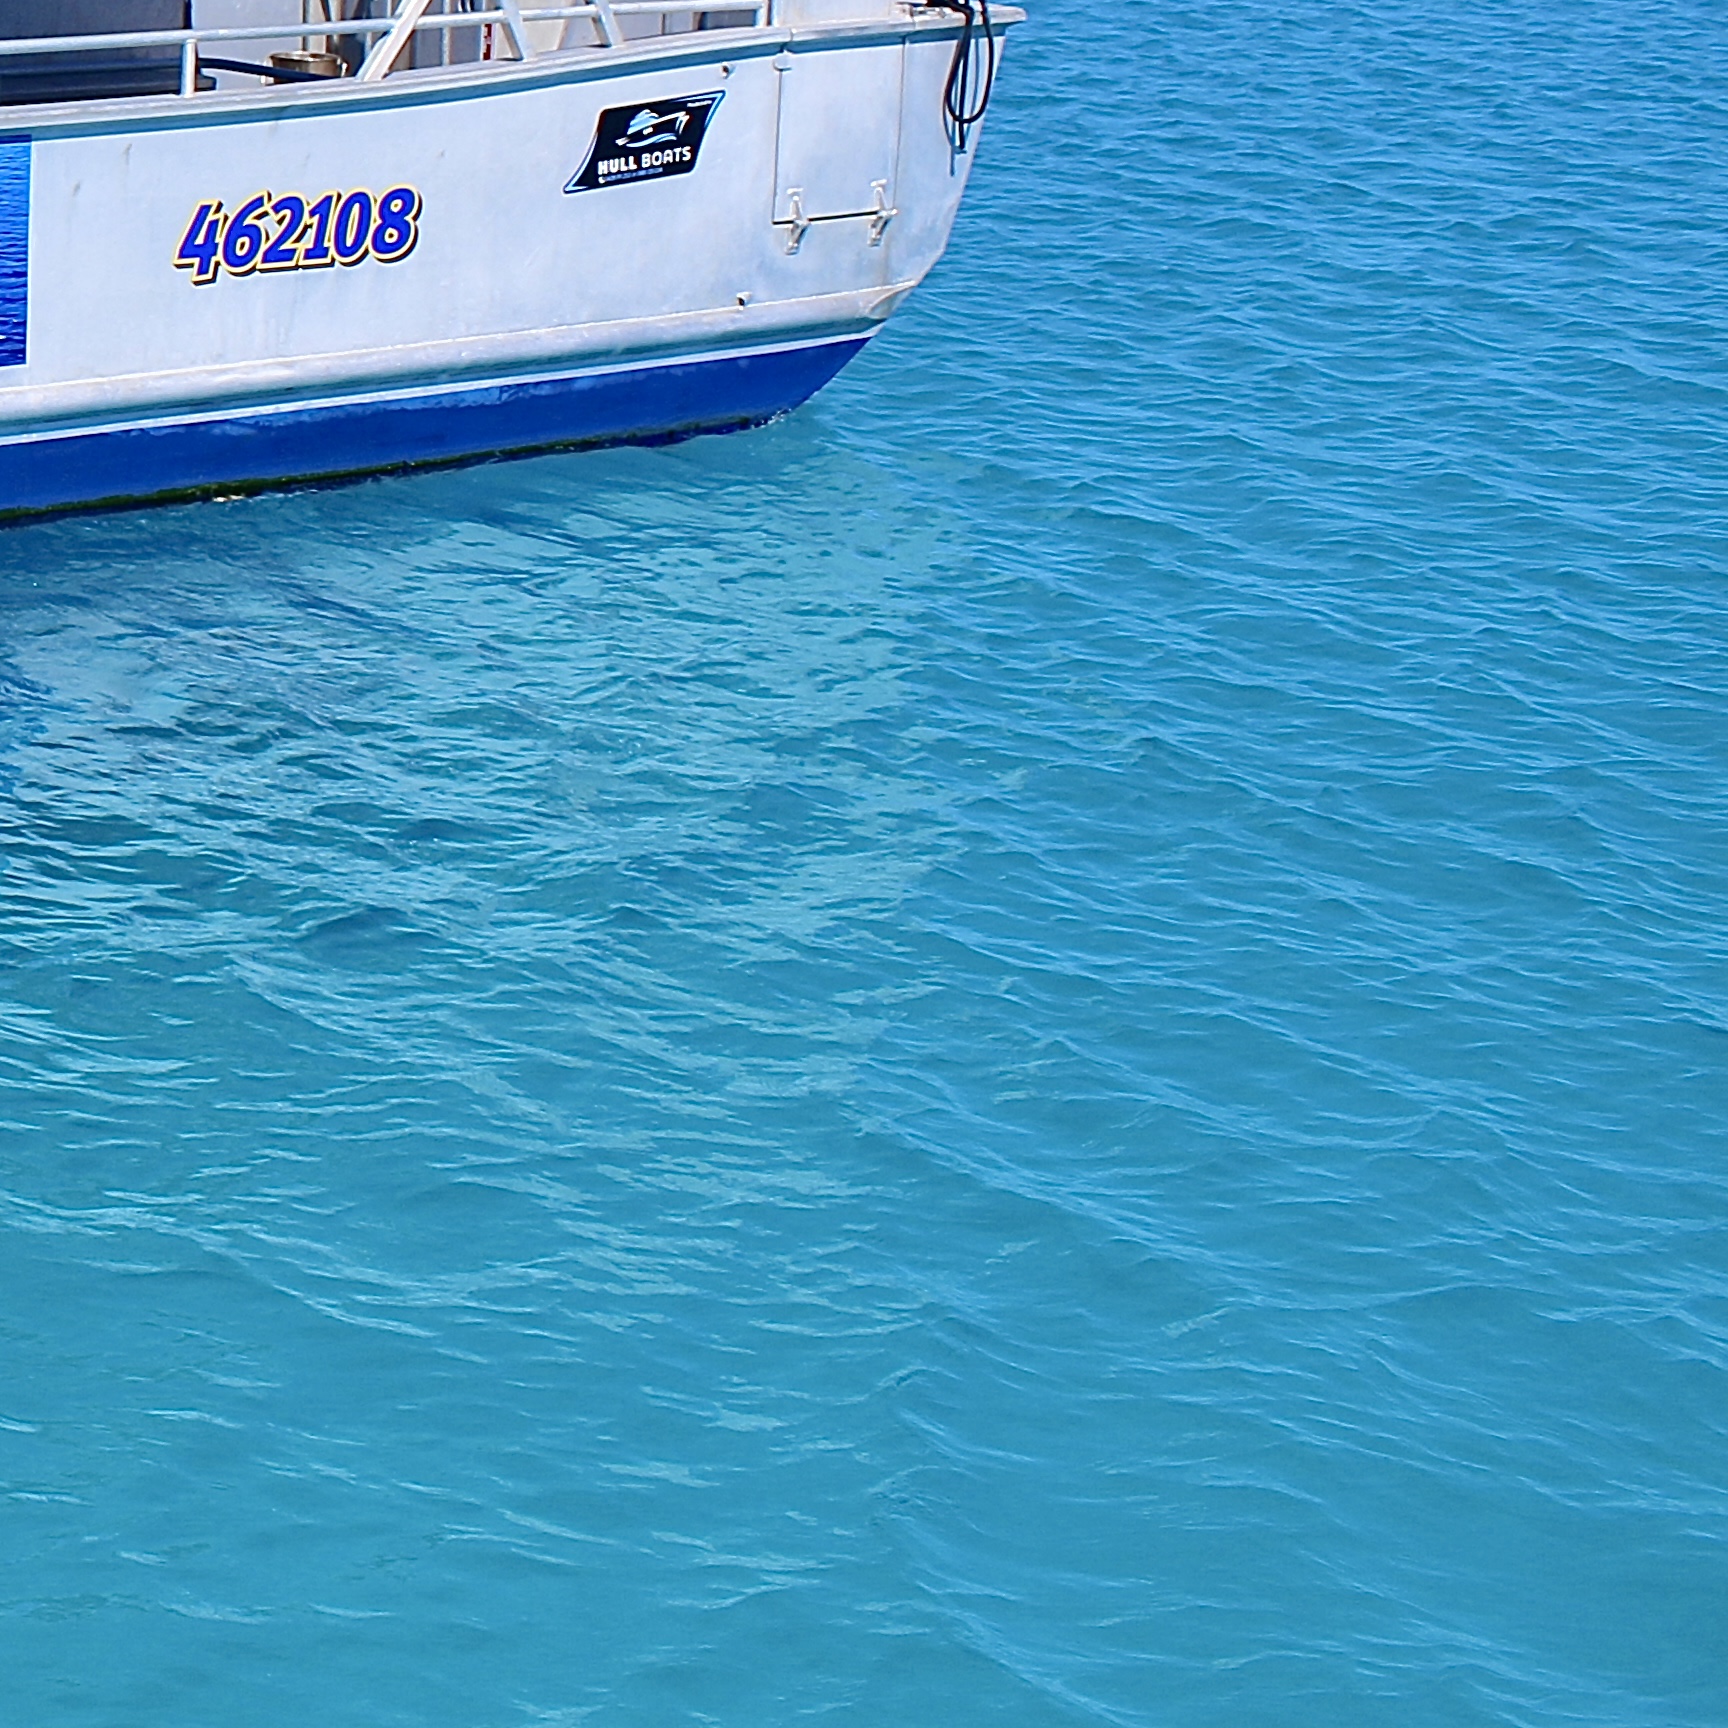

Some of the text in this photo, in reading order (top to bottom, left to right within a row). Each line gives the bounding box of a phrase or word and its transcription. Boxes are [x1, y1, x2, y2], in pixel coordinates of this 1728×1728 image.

[598, 156, 637, 175] HULL
[641, 146, 691, 168] BOATS
[173, 183, 422, 286] 462108
